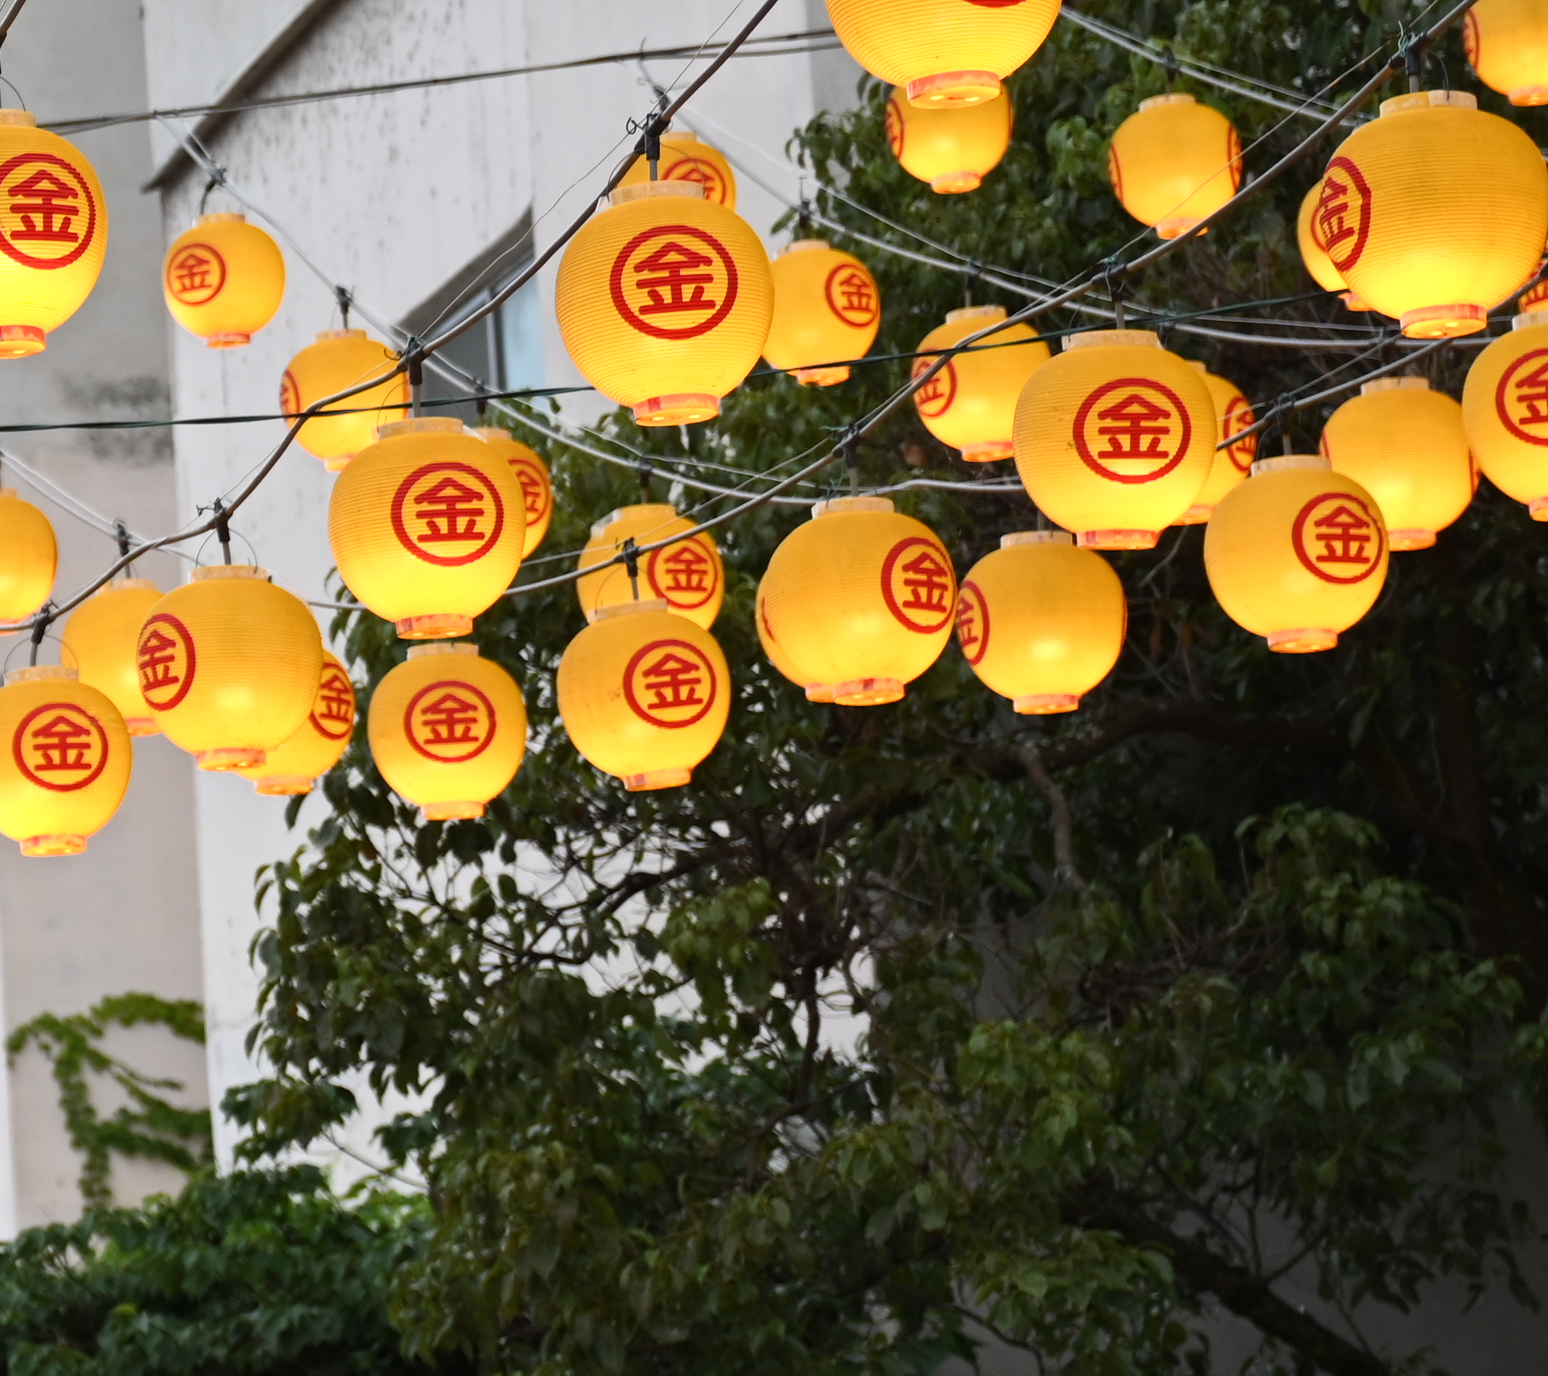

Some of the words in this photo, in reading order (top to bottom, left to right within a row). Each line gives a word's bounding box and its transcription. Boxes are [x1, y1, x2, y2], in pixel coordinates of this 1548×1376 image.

[8, 169, 80, 242] 金
[177, 254, 212, 292] 金
[634, 242, 717, 315] 金
[841, 274, 873, 312] 金
[1098, 394, 1172, 459] 金
[414, 477, 486, 543] 金
[1315, 505, 1372, 564] 金
[666, 547, 708, 592] 金
[903, 552, 949, 613] 金
[140, 630, 180, 692] 金
[643, 653, 704, 710] 金
[320, 674, 351, 723] 金
[423, 694, 480, 745] 金
[33, 715, 93, 772] 金
